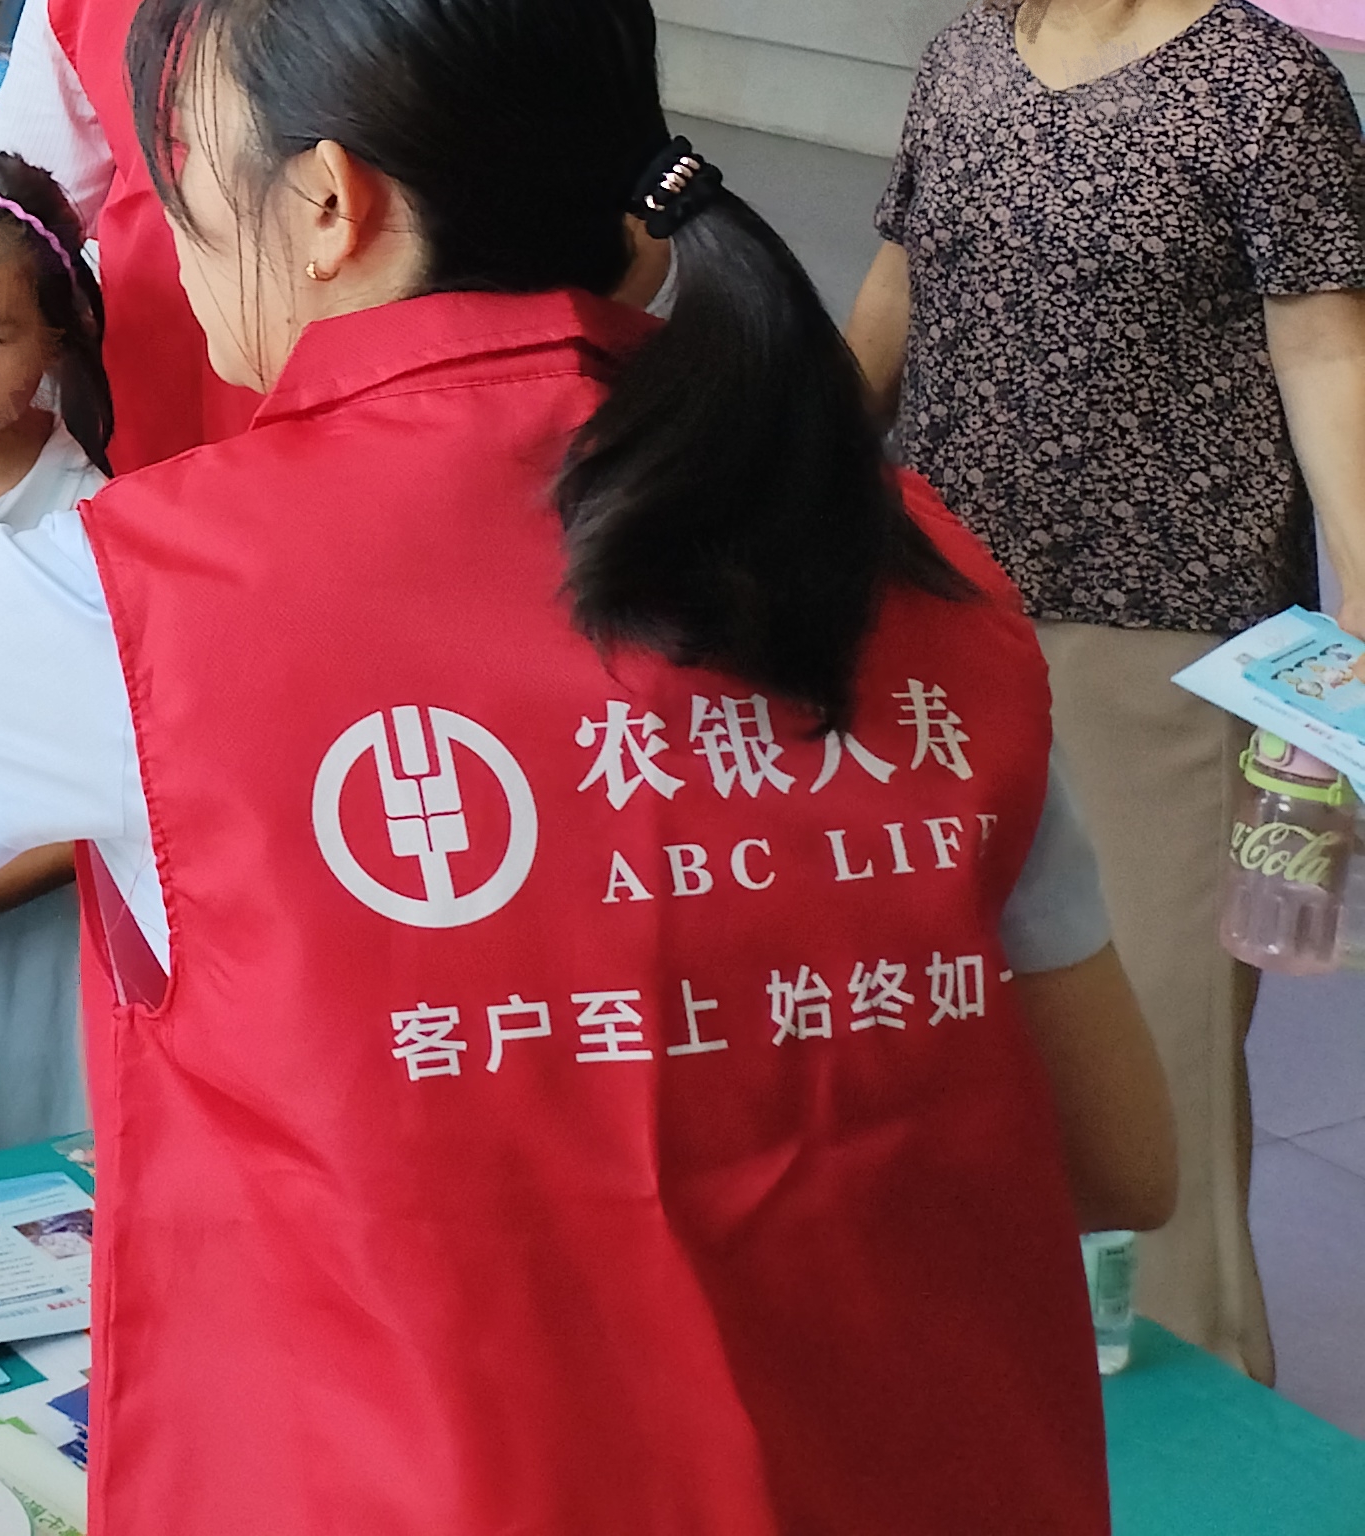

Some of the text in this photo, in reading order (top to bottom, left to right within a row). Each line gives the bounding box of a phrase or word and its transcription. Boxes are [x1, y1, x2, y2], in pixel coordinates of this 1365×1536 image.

[575, 678, 974, 811] 农银人寿
[602, 837, 777, 903] ABC
[390, 949, 1014, 1081] 客户至上 始终如
